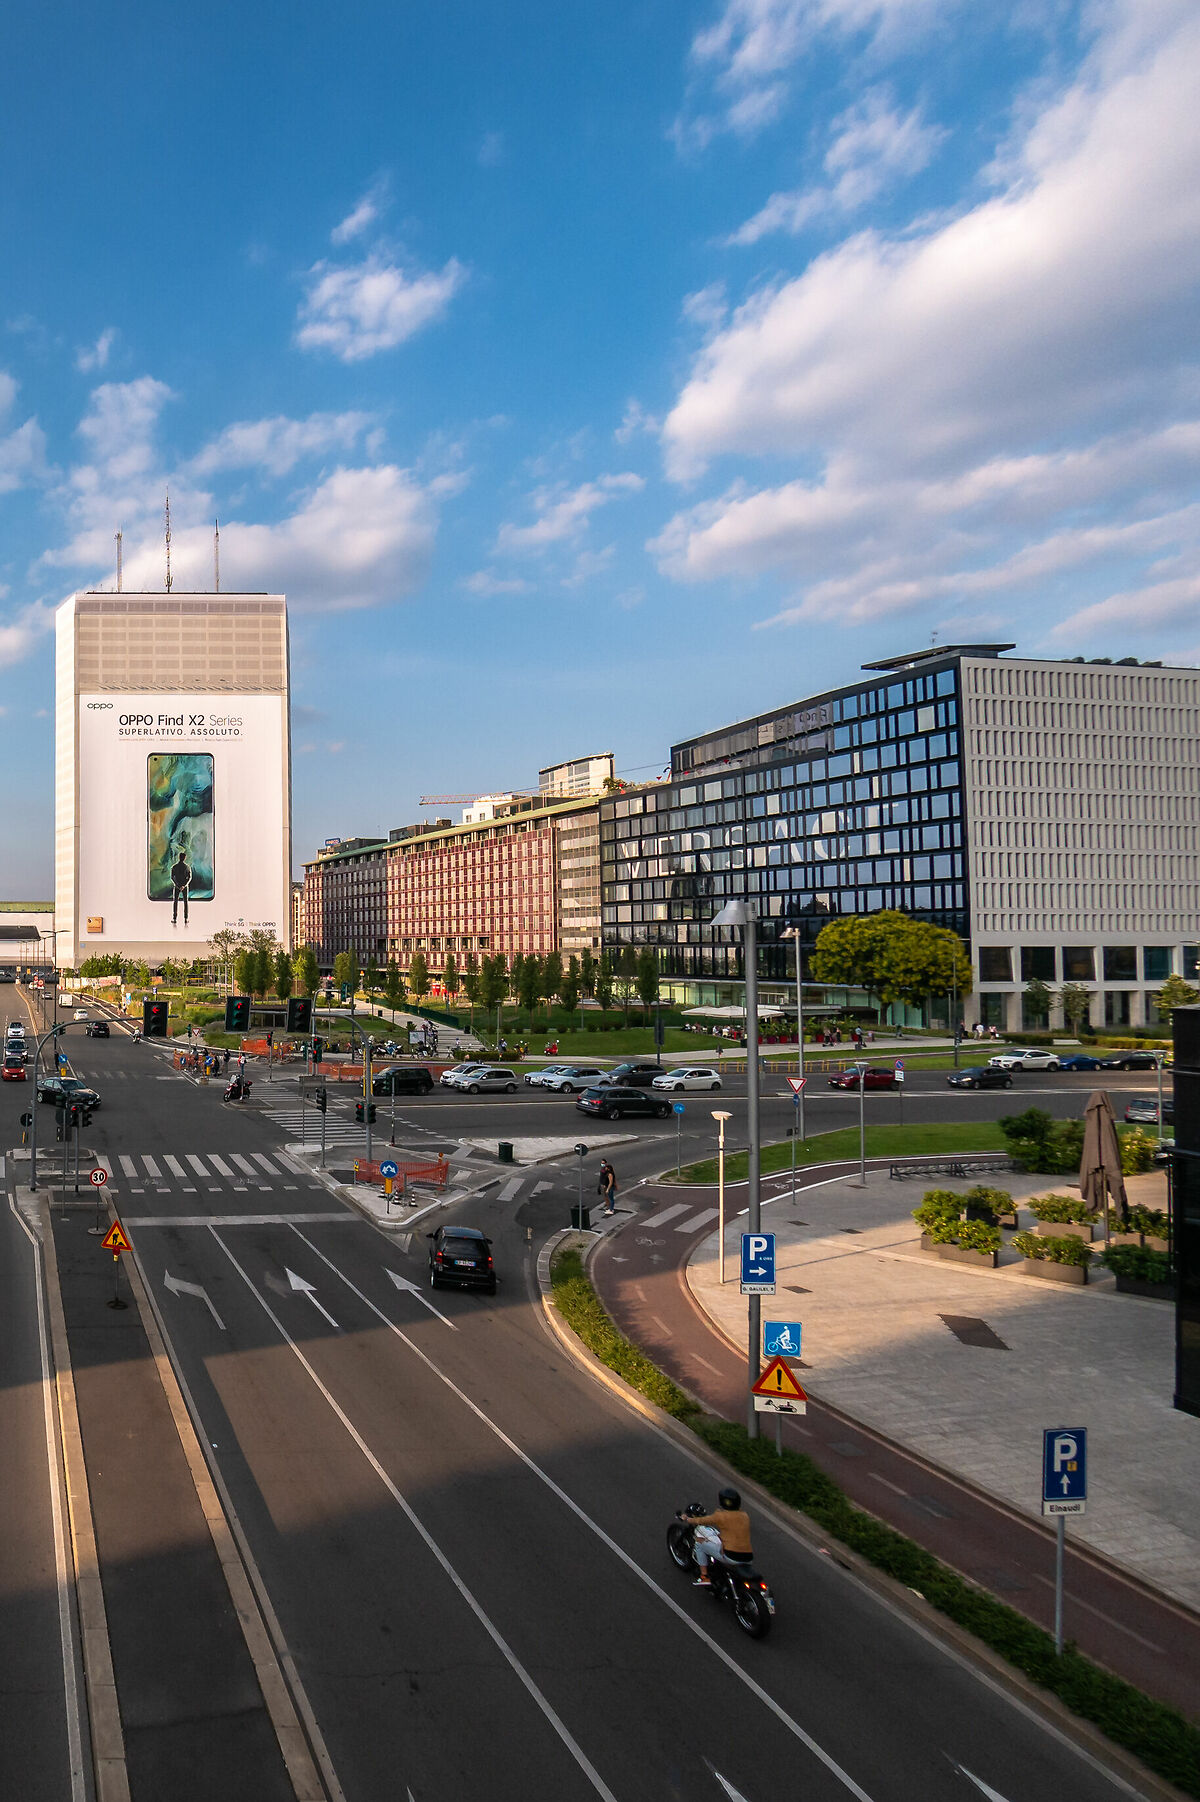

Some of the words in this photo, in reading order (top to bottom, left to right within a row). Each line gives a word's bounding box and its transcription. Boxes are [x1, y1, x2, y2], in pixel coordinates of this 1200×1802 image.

[86, 702, 114, 710] oppo
[119, 714, 154, 726] OPPO
[157, 714, 184, 726] Find
[188, 714, 205, 726] X2
[209, 714, 243, 727] Series
[118, 728, 187, 736] SUPERLATIVO.
[190, 728, 243, 736] ASSOLUTO.
[93, 1172, 105, 1182] 30
[750, 1237, 768, 1260] P
[1054, 1439, 1077, 1472] P
[1049, 1503, 1081, 1513] Einaudi
